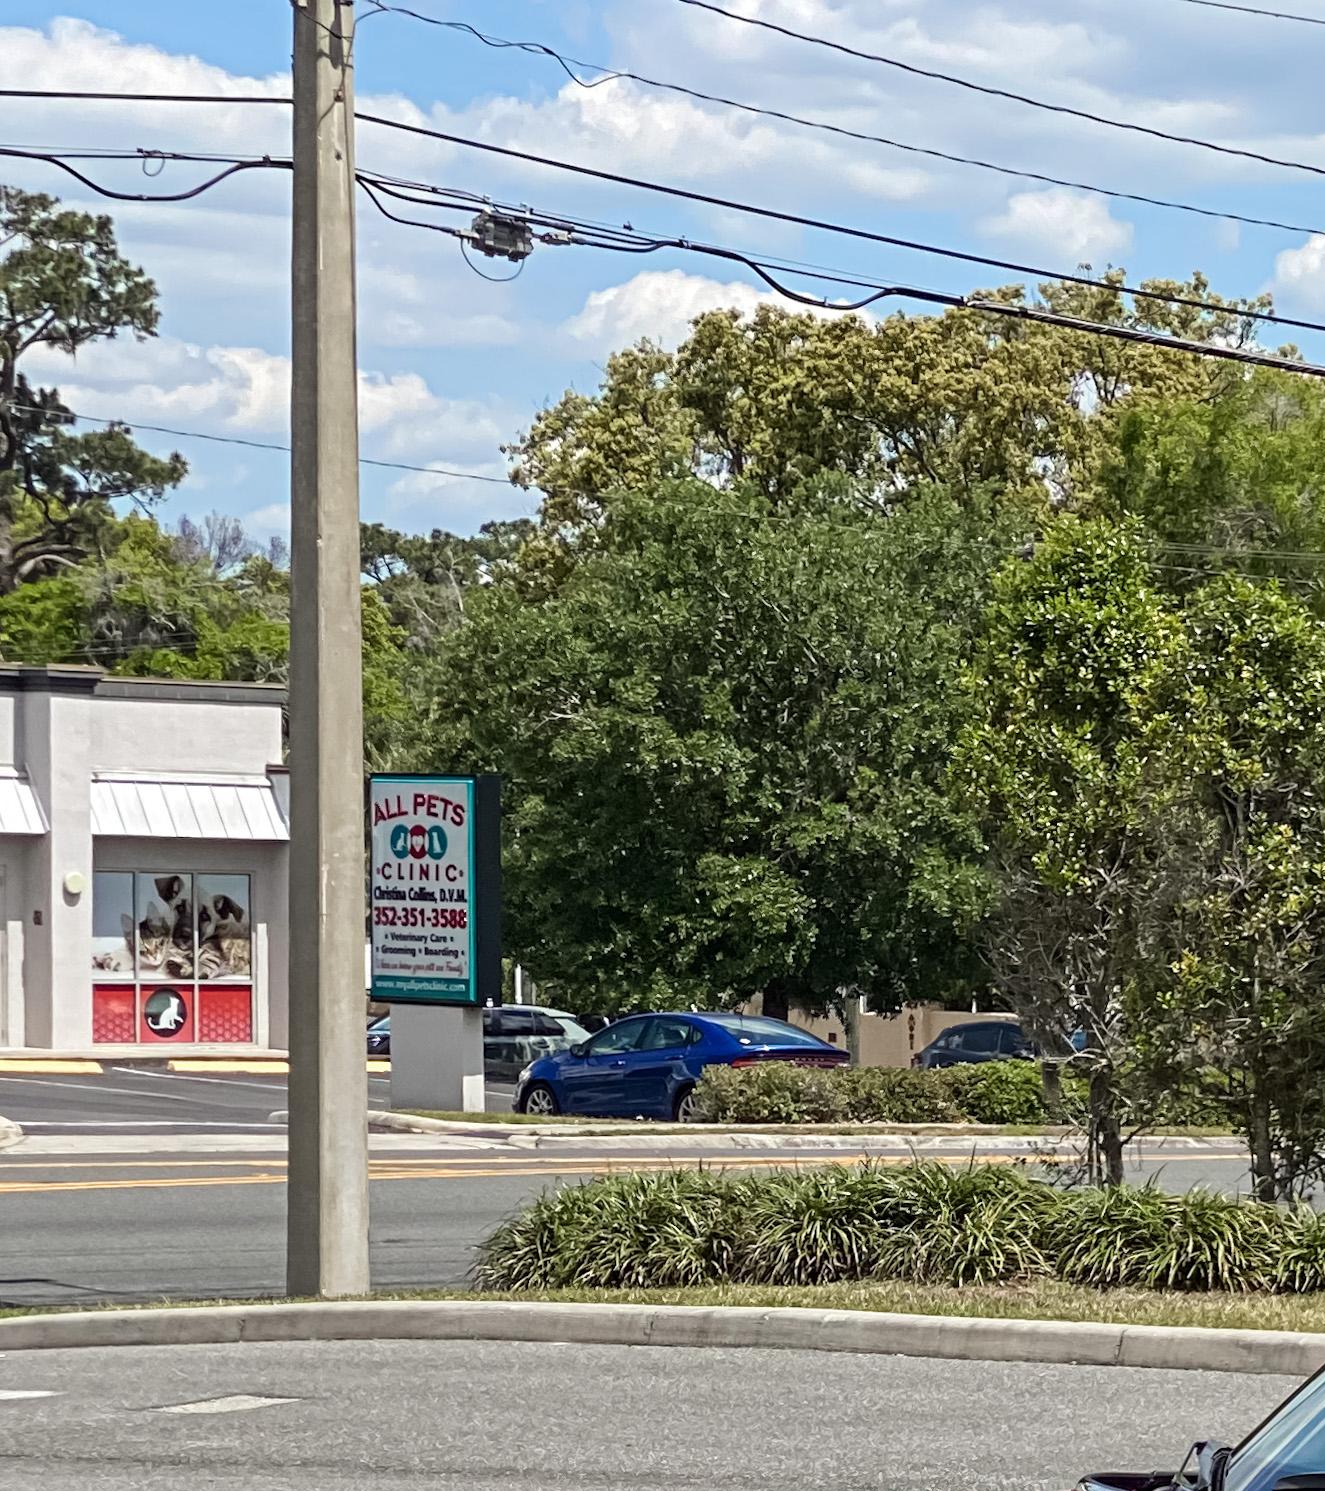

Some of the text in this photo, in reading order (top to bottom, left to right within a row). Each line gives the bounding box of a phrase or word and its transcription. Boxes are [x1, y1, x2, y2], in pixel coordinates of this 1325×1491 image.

[374, 792, 466, 827] ALL PETS
[381, 862, 457, 882] CLINIC
[374, 885, 467, 903] Christina Collins, D.V.M.
[374, 906, 467, 929] 352-351-3588
[390, 932, 447, 944] Veterinary Care
[381, 945, 459, 959] Grooming Boarding
